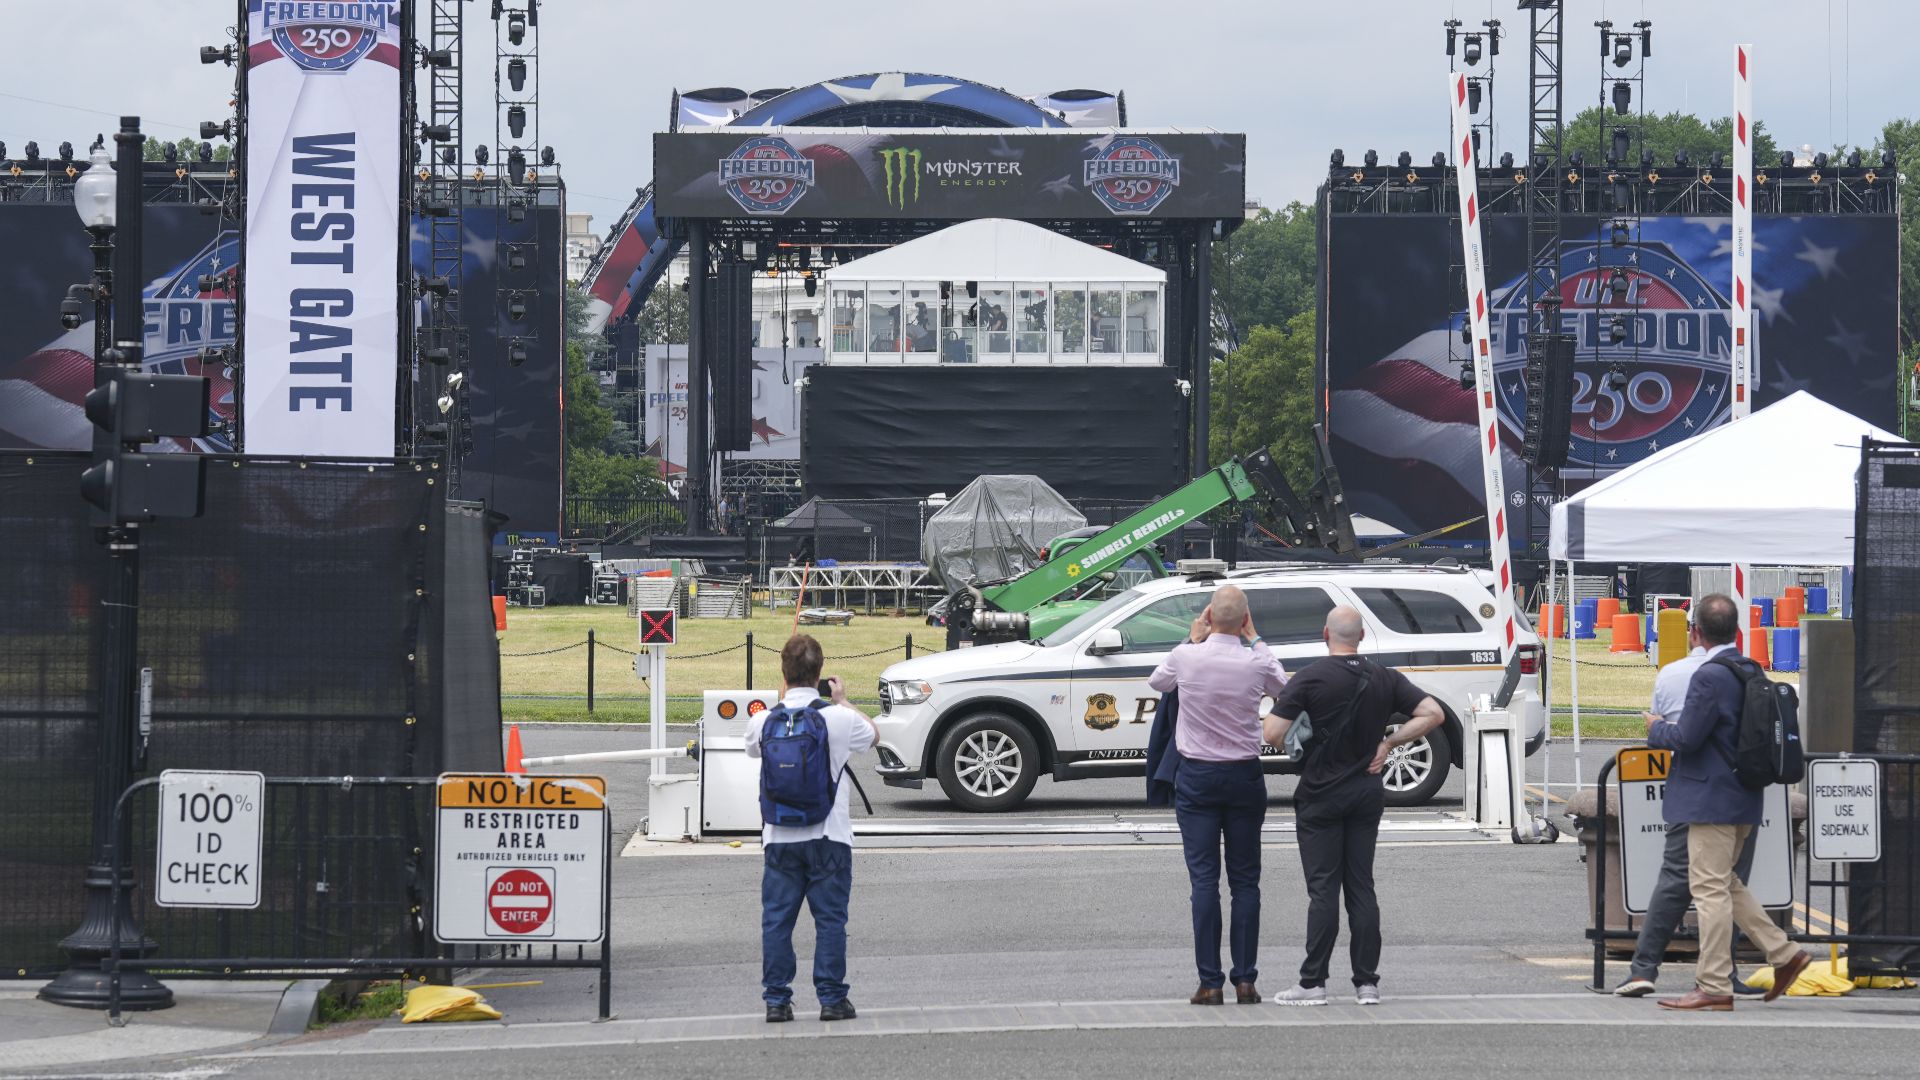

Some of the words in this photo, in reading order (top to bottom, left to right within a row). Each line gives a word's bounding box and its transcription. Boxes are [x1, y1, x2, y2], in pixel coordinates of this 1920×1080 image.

[264, 2, 386, 30] FREEDOM
[301, 28, 351, 54] 250
[754, 149, 779, 158] UFC
[1119, 149, 1143, 159] UFC
[720, 160, 813, 181] FREEDOM
[1085, 160, 1178, 181] FREEDOM
[748, 180, 787, 199] 250
[1113, 180, 1152, 199] 250
[291, 132, 355, 274] WEST
[289, 288, 354, 412] GATE
[650, 392, 688, 408] FREE
[671, 406, 688, 421] 25
[1080, 533, 1133, 569] SUNBELT
[1132, 508, 1186, 541] RENTALS
[1470, 651, 1496, 663] 1633
[1088, 749, 1138, 759] UNITED
[468, 781, 576, 805] NOTICE
[1815, 785, 1873, 797] PEDESTRIANS
[1835, 804, 1855, 817] USE
[464, 812, 579, 829] RESTRICTED
[1641, 823, 1668, 833] AUTHO
[1821, 824, 1869, 836] SIDEWALK
[197, 832, 222, 854] ID
[497, 833, 546, 848] AREA
[457, 852, 512, 861] AUTHORIZED
[517, 853, 559, 861] VEHICLES
[563, 854, 586, 862] ONLY
[168, 862, 249, 885] CHECK
[497, 882, 513, 892] DO
[520, 882, 543, 892] NOT
[501, 911, 538, 922] ENTER
